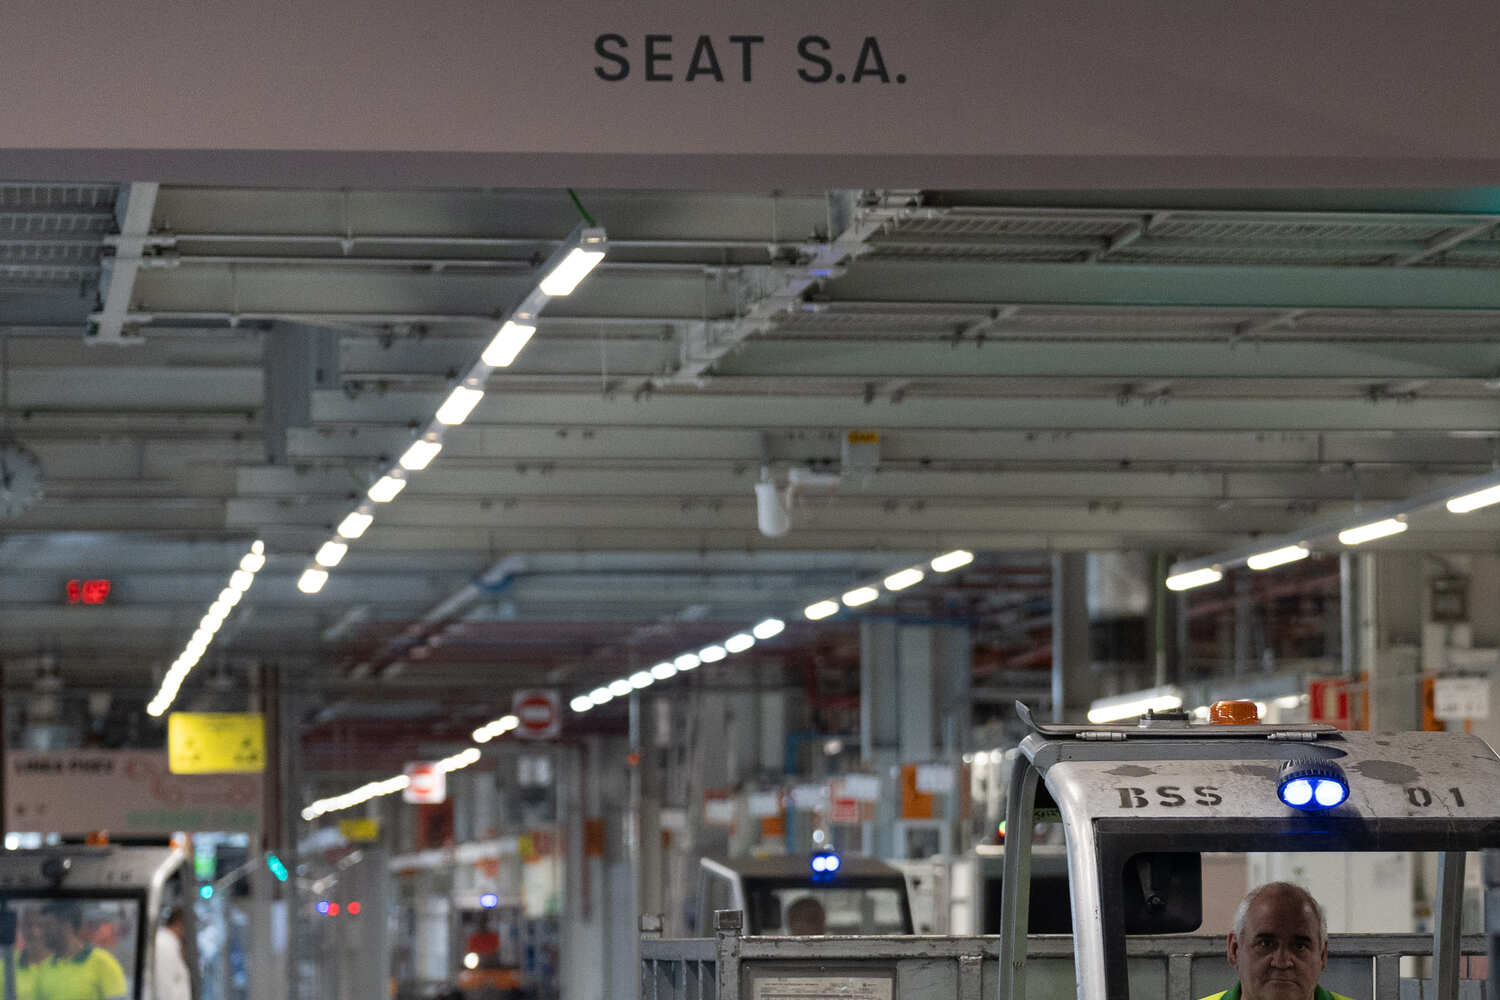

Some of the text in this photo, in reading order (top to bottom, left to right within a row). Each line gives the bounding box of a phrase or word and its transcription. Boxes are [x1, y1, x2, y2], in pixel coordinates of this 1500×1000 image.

[593, 33, 907, 84] SEAT S.A.
[1115, 785, 1224, 809] BSS
